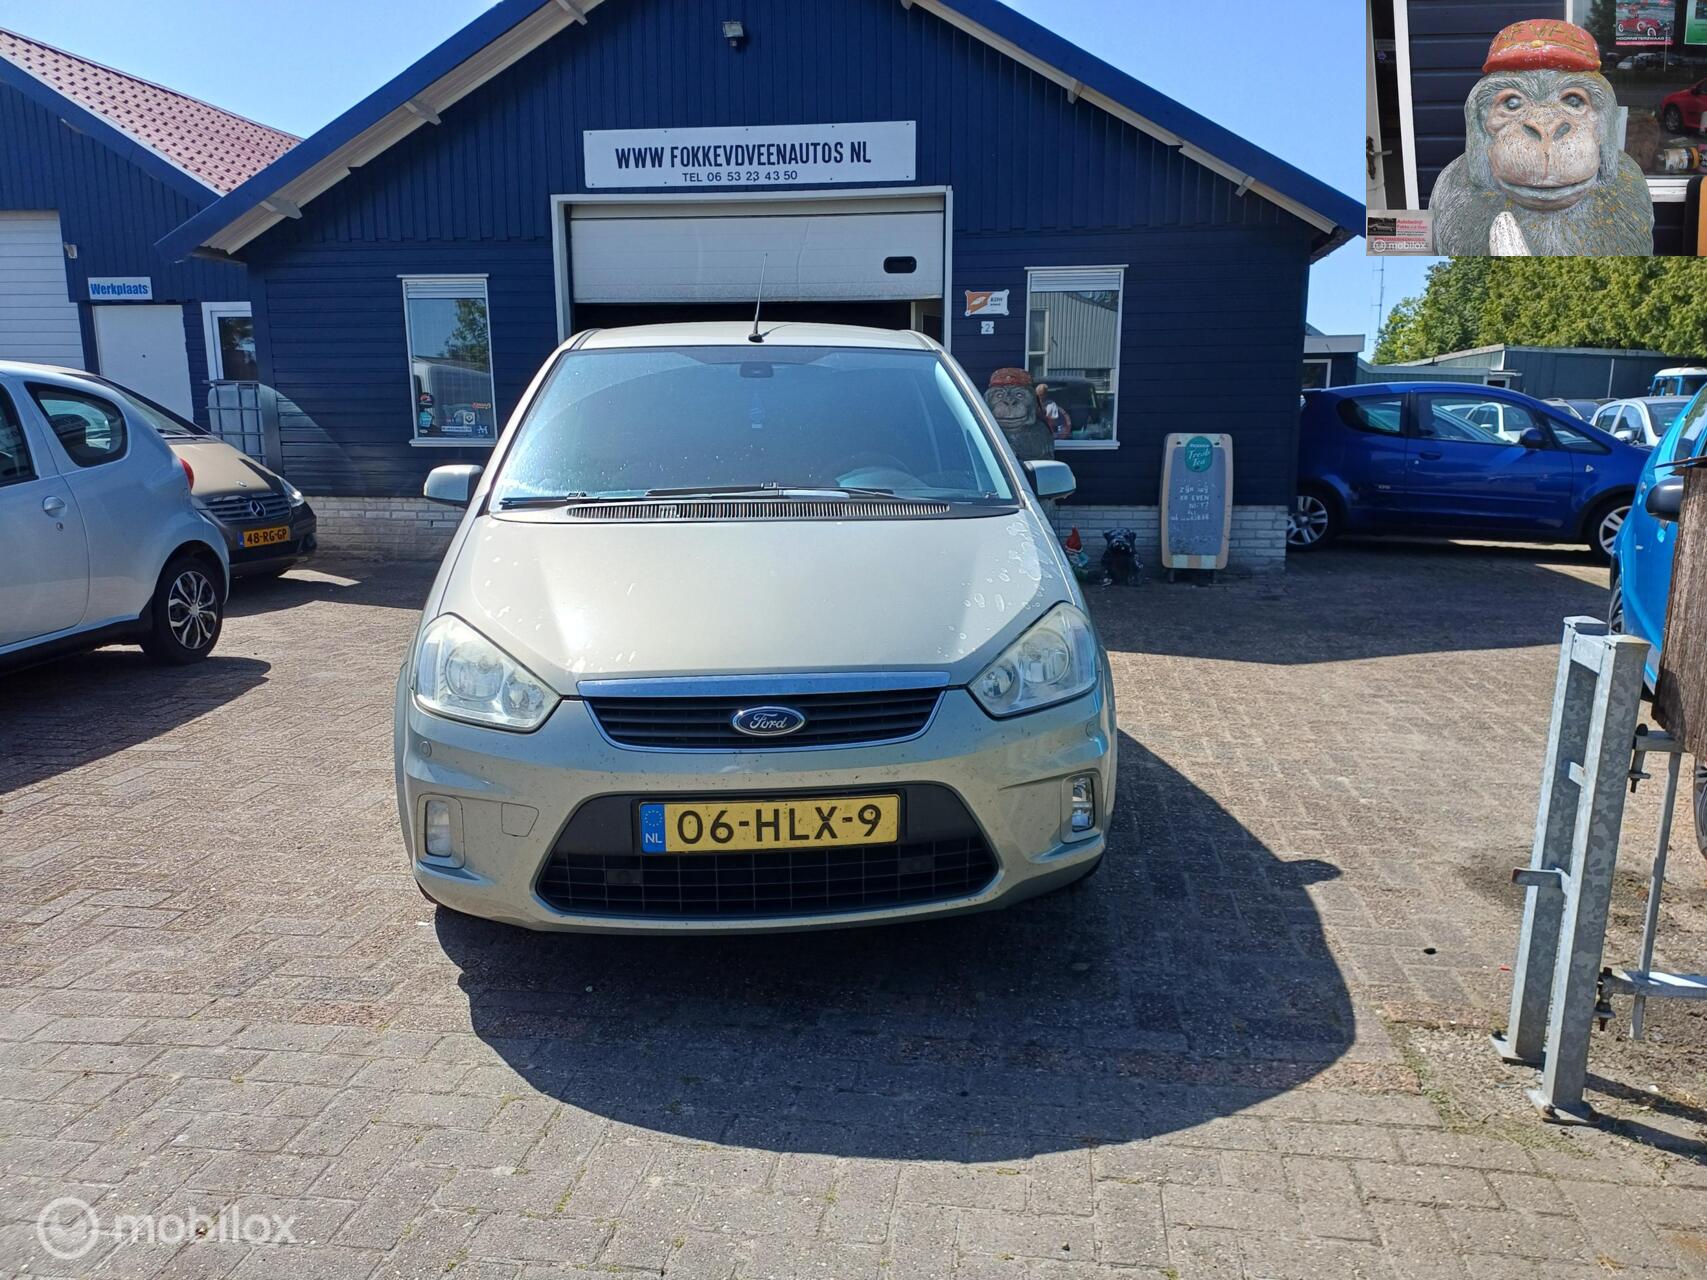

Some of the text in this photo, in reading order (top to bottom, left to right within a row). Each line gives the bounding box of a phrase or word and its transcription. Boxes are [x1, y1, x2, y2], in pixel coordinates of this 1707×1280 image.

[615, 141, 872, 169] WWW FOKKEVDVEENAUTOS NL
[682, 170, 798, 183] TEL 06 53 23 43 50
[91, 283, 149, 295] Werkplaats
[247, 528, 287, 544] 48-RG-GP
[749, 712, 788, 729] Ford
[645, 804, 882, 844] NL 06-HLX-9
